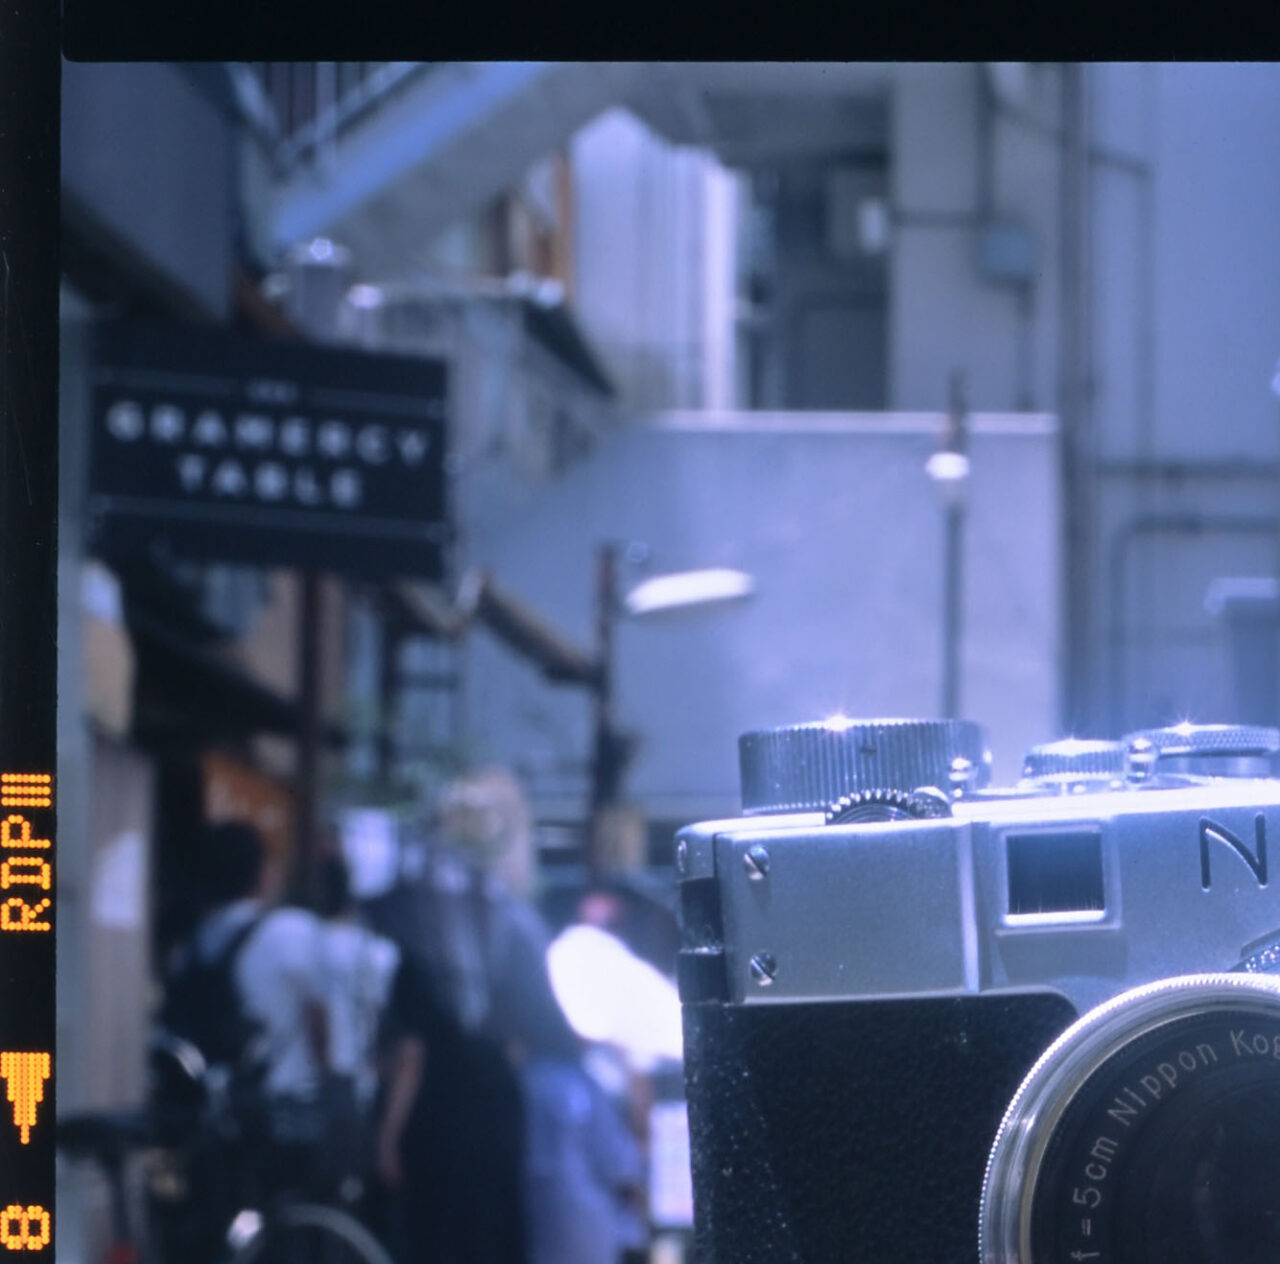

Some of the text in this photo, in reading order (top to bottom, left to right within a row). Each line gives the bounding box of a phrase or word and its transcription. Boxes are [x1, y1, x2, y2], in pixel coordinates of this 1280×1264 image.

[176, 453, 364, 509] TABLE
[1107, 1042, 1218, 1127] Nippon
[0, 1205, 50, 1251] 8
